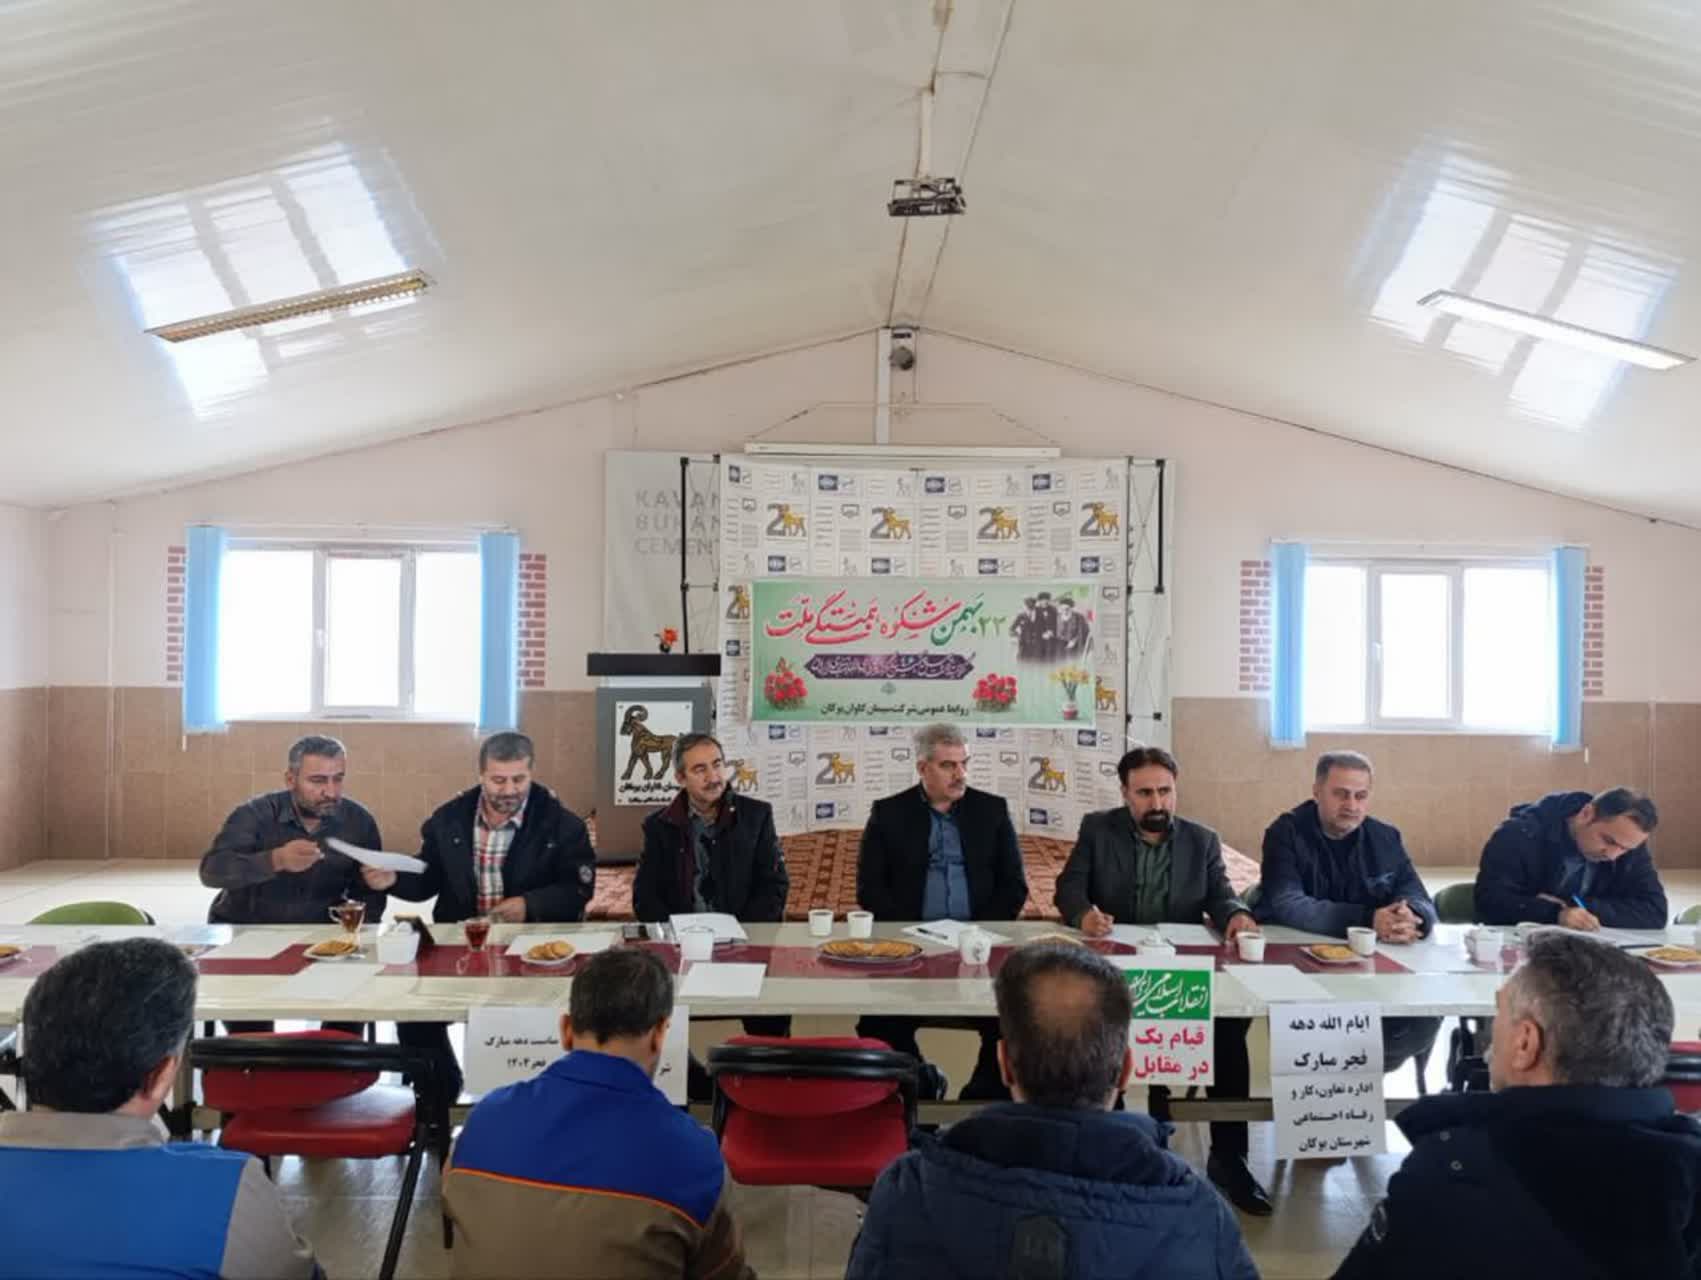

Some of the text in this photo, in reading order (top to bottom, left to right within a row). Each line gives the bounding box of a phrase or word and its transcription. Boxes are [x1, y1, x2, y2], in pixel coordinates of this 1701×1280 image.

[1289, 1014, 1370, 1034] ایام الله دهه
[1135, 1026, 1205, 1050] قیام یک
[1135, 1055, 1209, 1080] در مقابل
[1294, 1049, 1367, 1072] فجر مبارک
[1347, 1081, 1374, 1097] اداره
[1298, 1133, 1371, 1152] شهرستان بوکان
